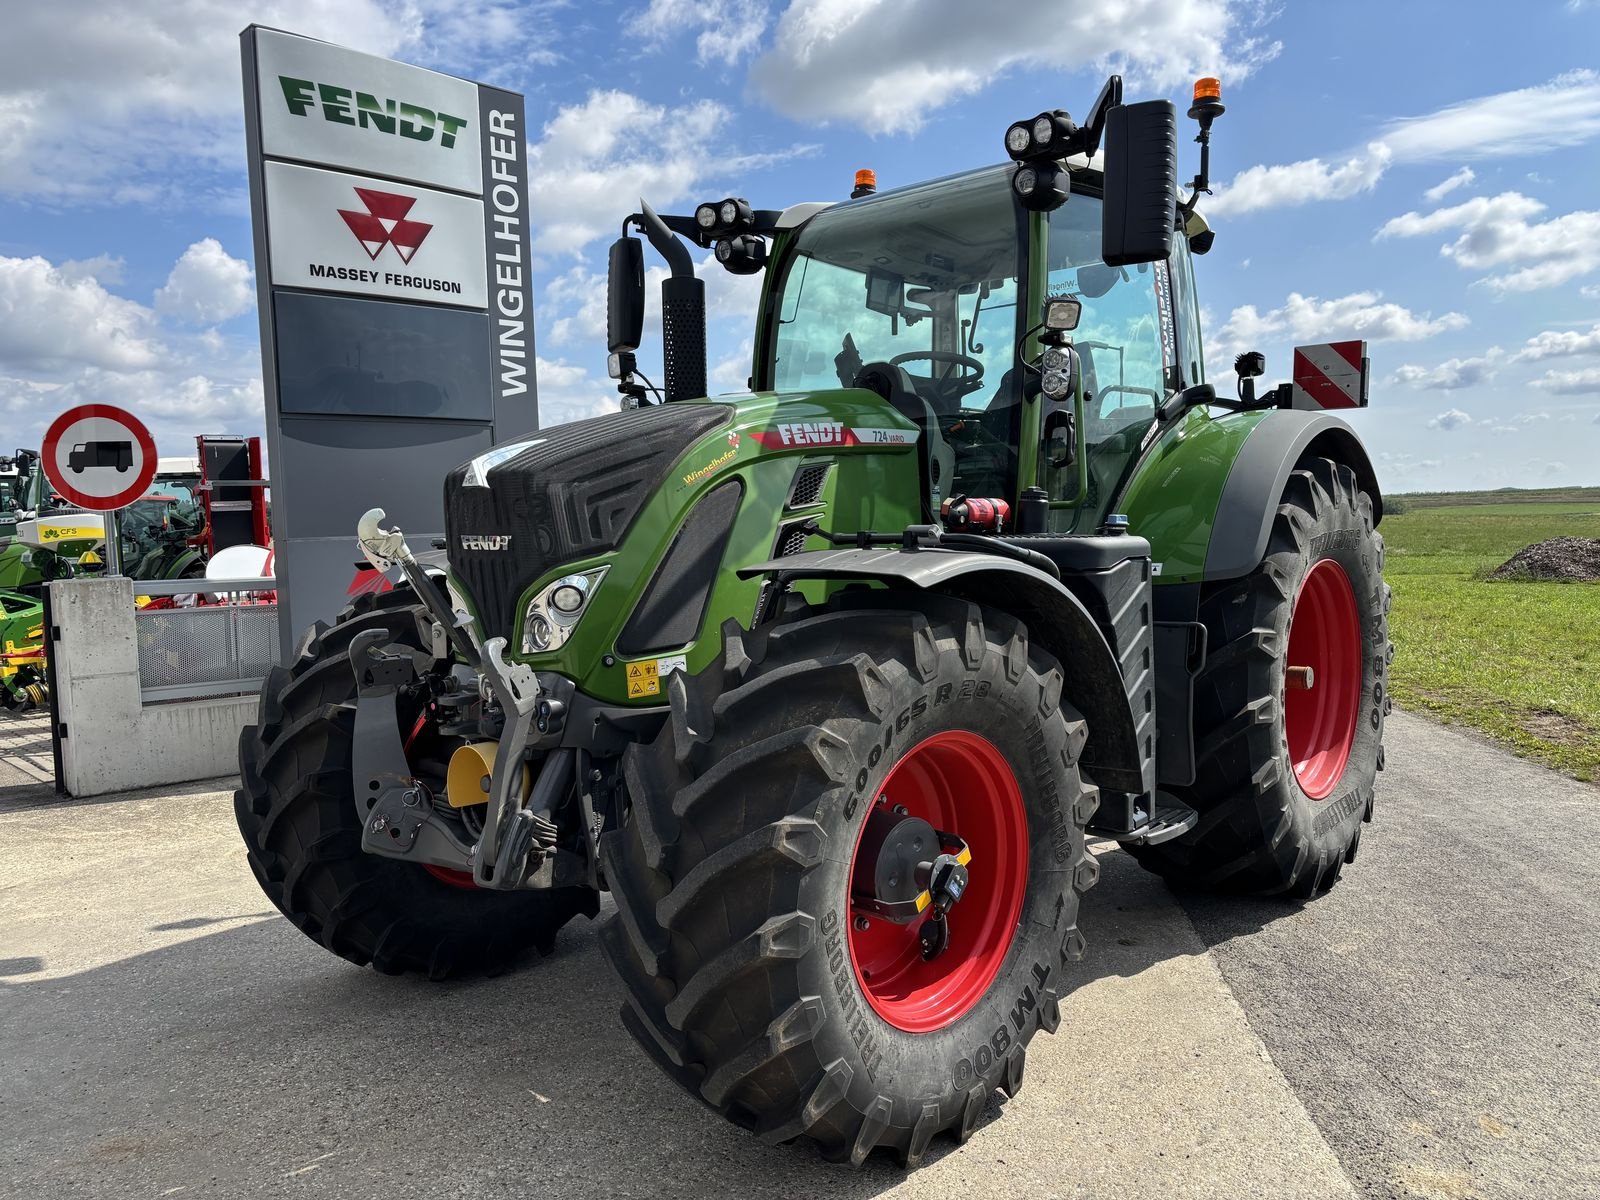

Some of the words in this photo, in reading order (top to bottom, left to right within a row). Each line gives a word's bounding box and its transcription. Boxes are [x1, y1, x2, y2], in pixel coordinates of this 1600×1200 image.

[278, 75, 468, 149] FENDT
[309, 263, 380, 284] MASSEY
[384, 272, 462, 294] FERGUSON
[488, 108, 528, 397] WINGELHOFER
[777, 421, 845, 446] FENDT
[872, 430, 889, 443] 724
[889, 434, 905, 443] VARIO
[60, 527, 77, 535] CFS
[461, 534, 512, 551] FENDT
[1367, 584, 1385, 649] TM
[1371, 655, 1384, 732] 800
[1008, 961, 1052, 1036] TM
[952, 1023, 1012, 1092] 800
